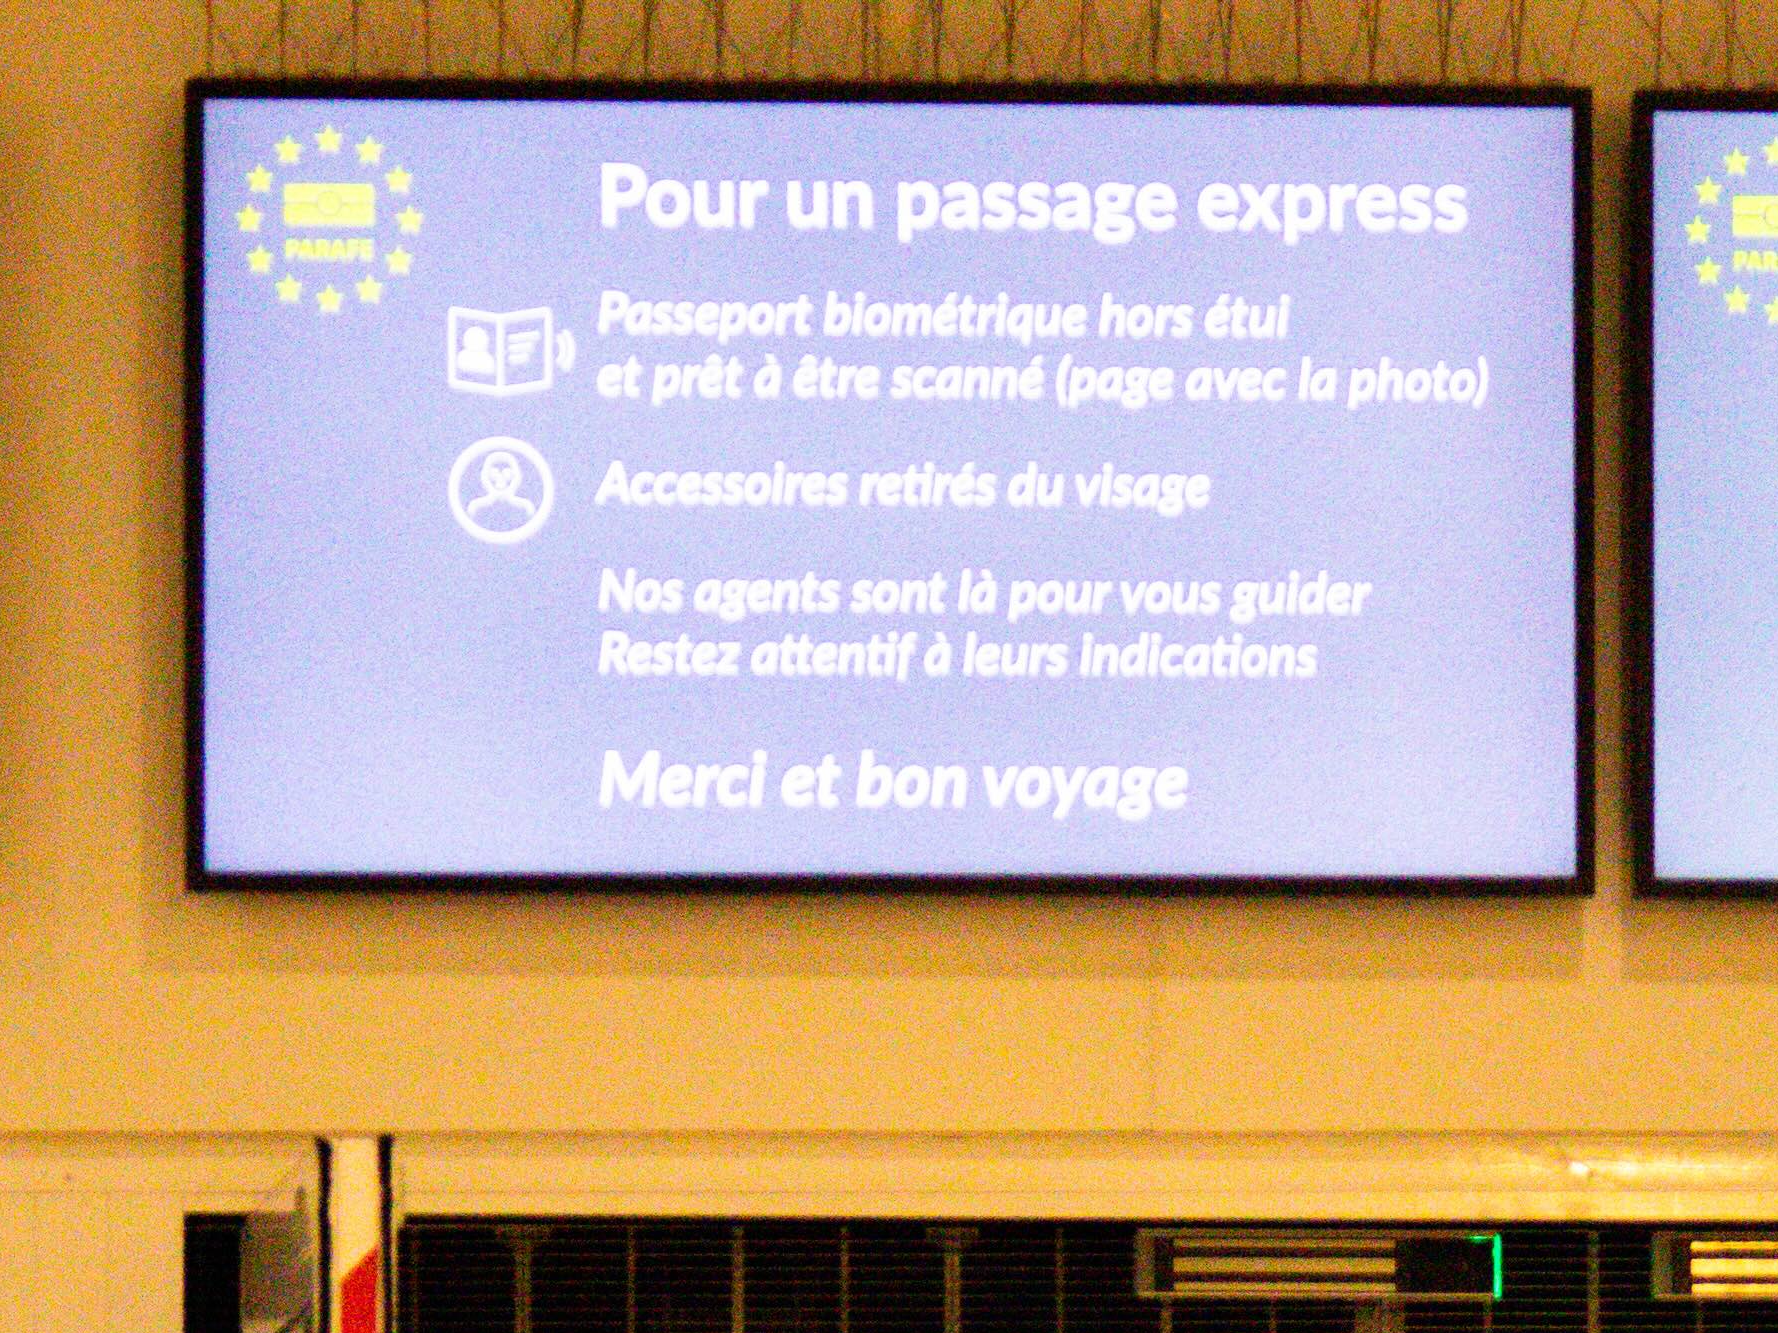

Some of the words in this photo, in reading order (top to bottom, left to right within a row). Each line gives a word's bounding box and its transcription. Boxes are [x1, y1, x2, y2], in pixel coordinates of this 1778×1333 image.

[601, 163, 769, 230] Pour
[787, 181, 874, 230] un
[897, 181, 1177, 245] passage
[1198, 183, 1468, 246] express
[280, 235, 374, 262] PARAFE
[597, 290, 813, 344] Passeport
[824, 291, 1088, 345] biométrique
[1099, 293, 1193, 339] hors
[1204, 294, 1291, 339] étui
[596, 356, 643, 398] et
[651, 354, 744, 406] prêt
[754, 354, 782, 399] à
[792, 355, 880, 399] être
[891, 356, 1044, 400] scanné
[1056, 354, 1174, 410] (page
[1185, 367, 1287, 402] avec
[1298, 357, 1338, 401] la
[1347, 357, 1489, 410] photo)
[595, 461, 848, 506] Accessoires
[859, 462, 997, 507] retirés
[1007, 462, 1064, 507] du
[1075, 463, 1211, 517] visage
[598, 568, 683, 613] Nos
[694, 572, 840, 622] agents
[851, 573, 947, 614] sont
[958, 569, 998, 613] là
[1008, 581, 1113, 622] pour
[1120, 581, 1221, 615] vous
[1229, 570, 1373, 624] guider
[599, 631, 741, 676] Restez
[751, 632, 917, 681] attentif
[924, 632, 952, 676] à
[963, 632, 1068, 677] leurs
[1079, 632, 1318, 678] indications
[599, 750, 767, 808] Merci
[780, 755, 842, 808] et
[856, 750, 968, 808] bon
[983, 766, 1188, 822] voyage
